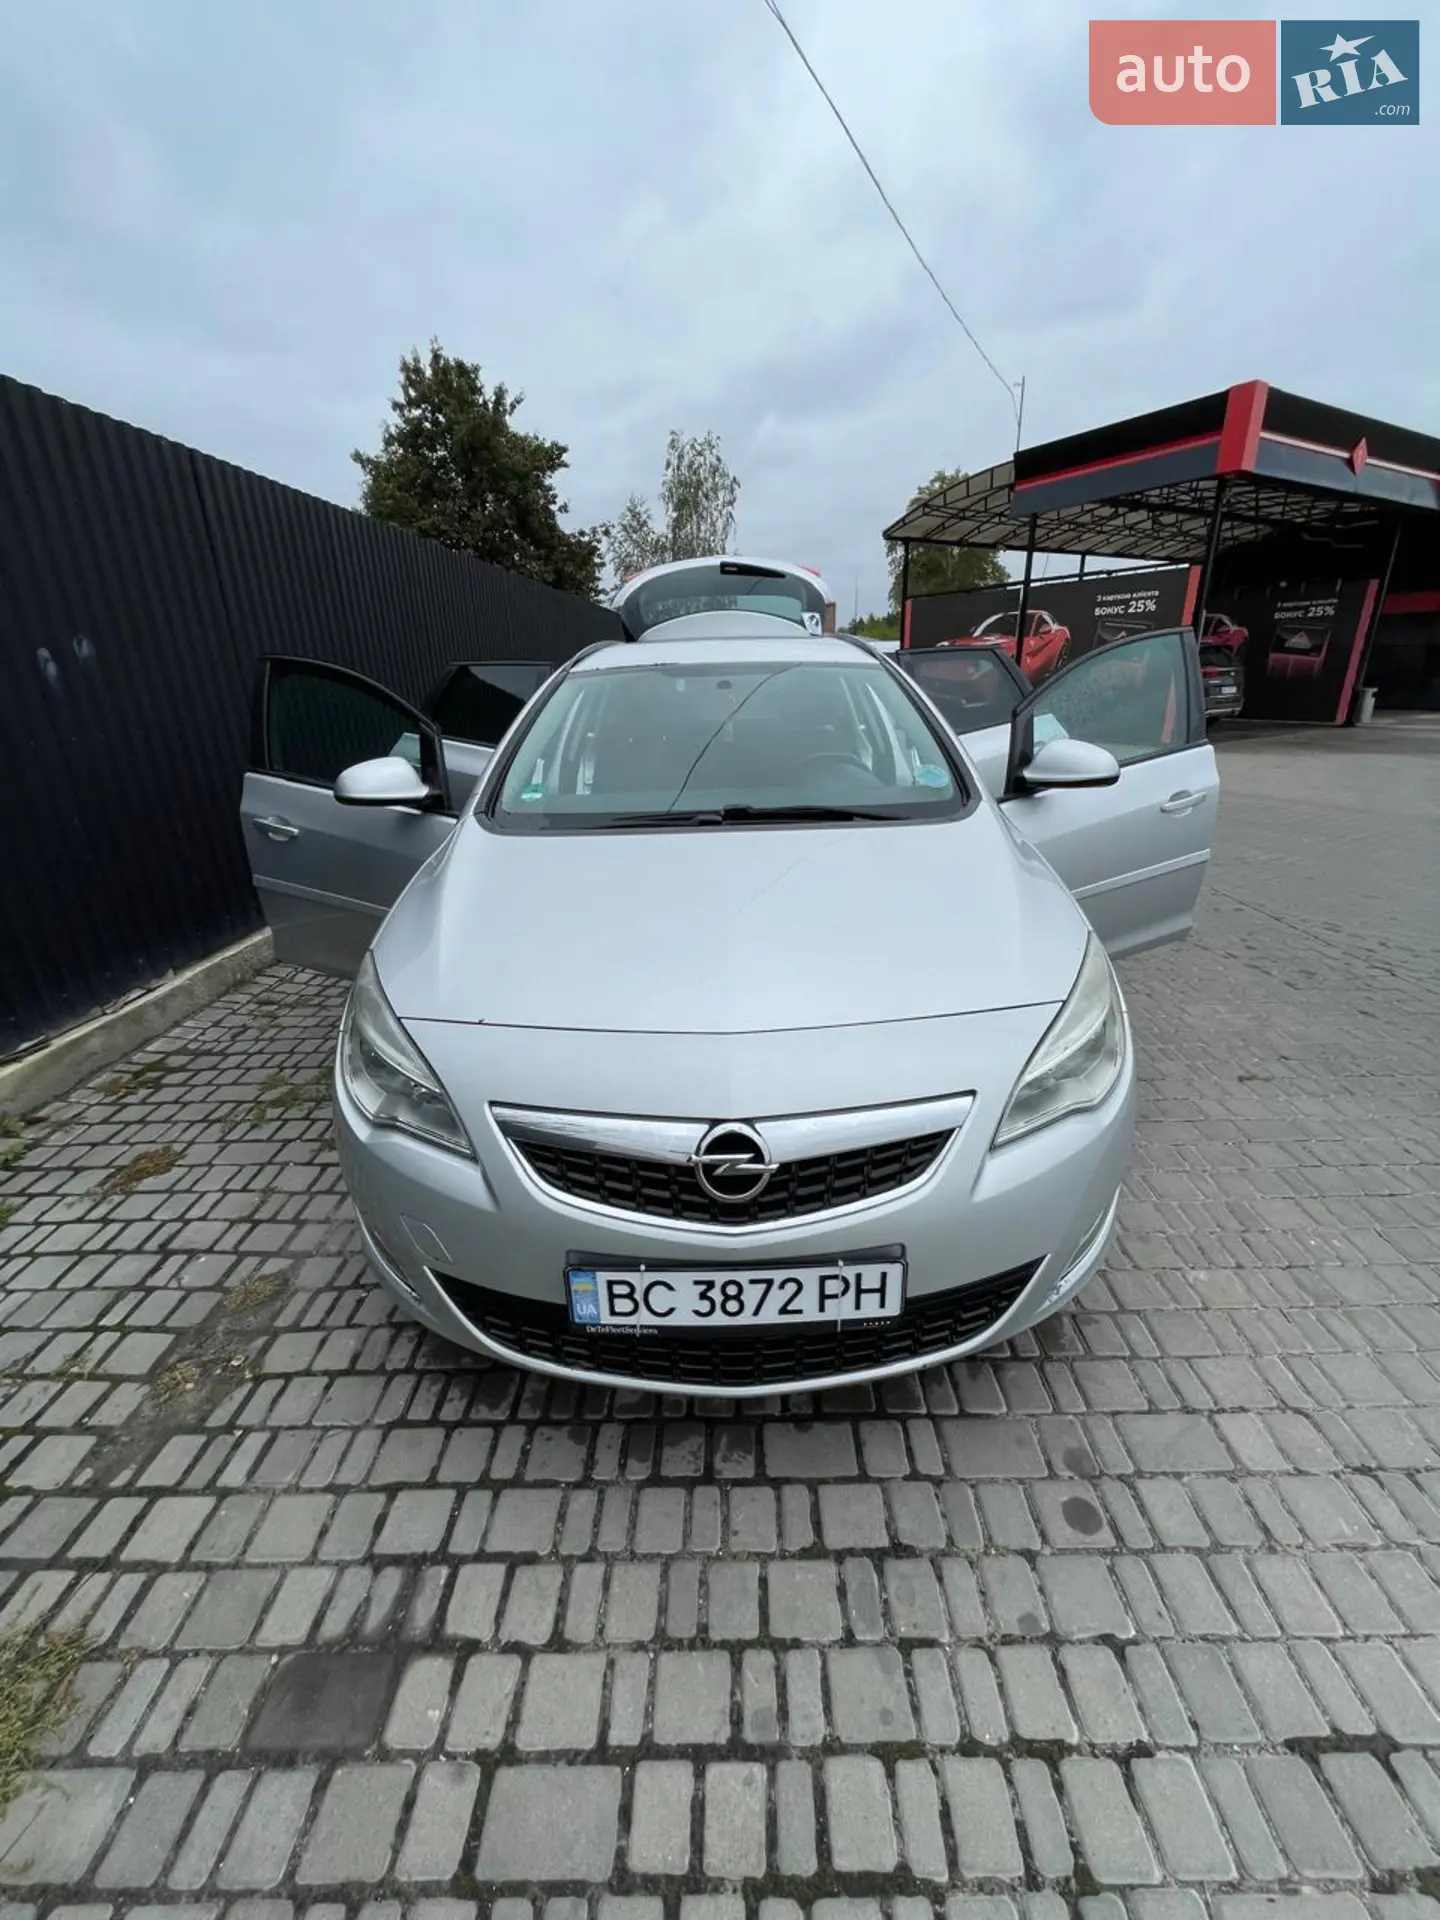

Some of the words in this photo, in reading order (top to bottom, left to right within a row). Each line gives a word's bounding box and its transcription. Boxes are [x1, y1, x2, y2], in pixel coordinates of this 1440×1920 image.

[1094, 605, 1126, 616] БОНУС
[1127, 598, 1156, 613] 25%
[1307, 605, 1335, 617] 25%
[606, 1279, 677, 1318] BC
[691, 1277, 804, 1318] 3872
[818, 1271, 888, 1313] PH
[576, 1303, 598, 1317] UA
